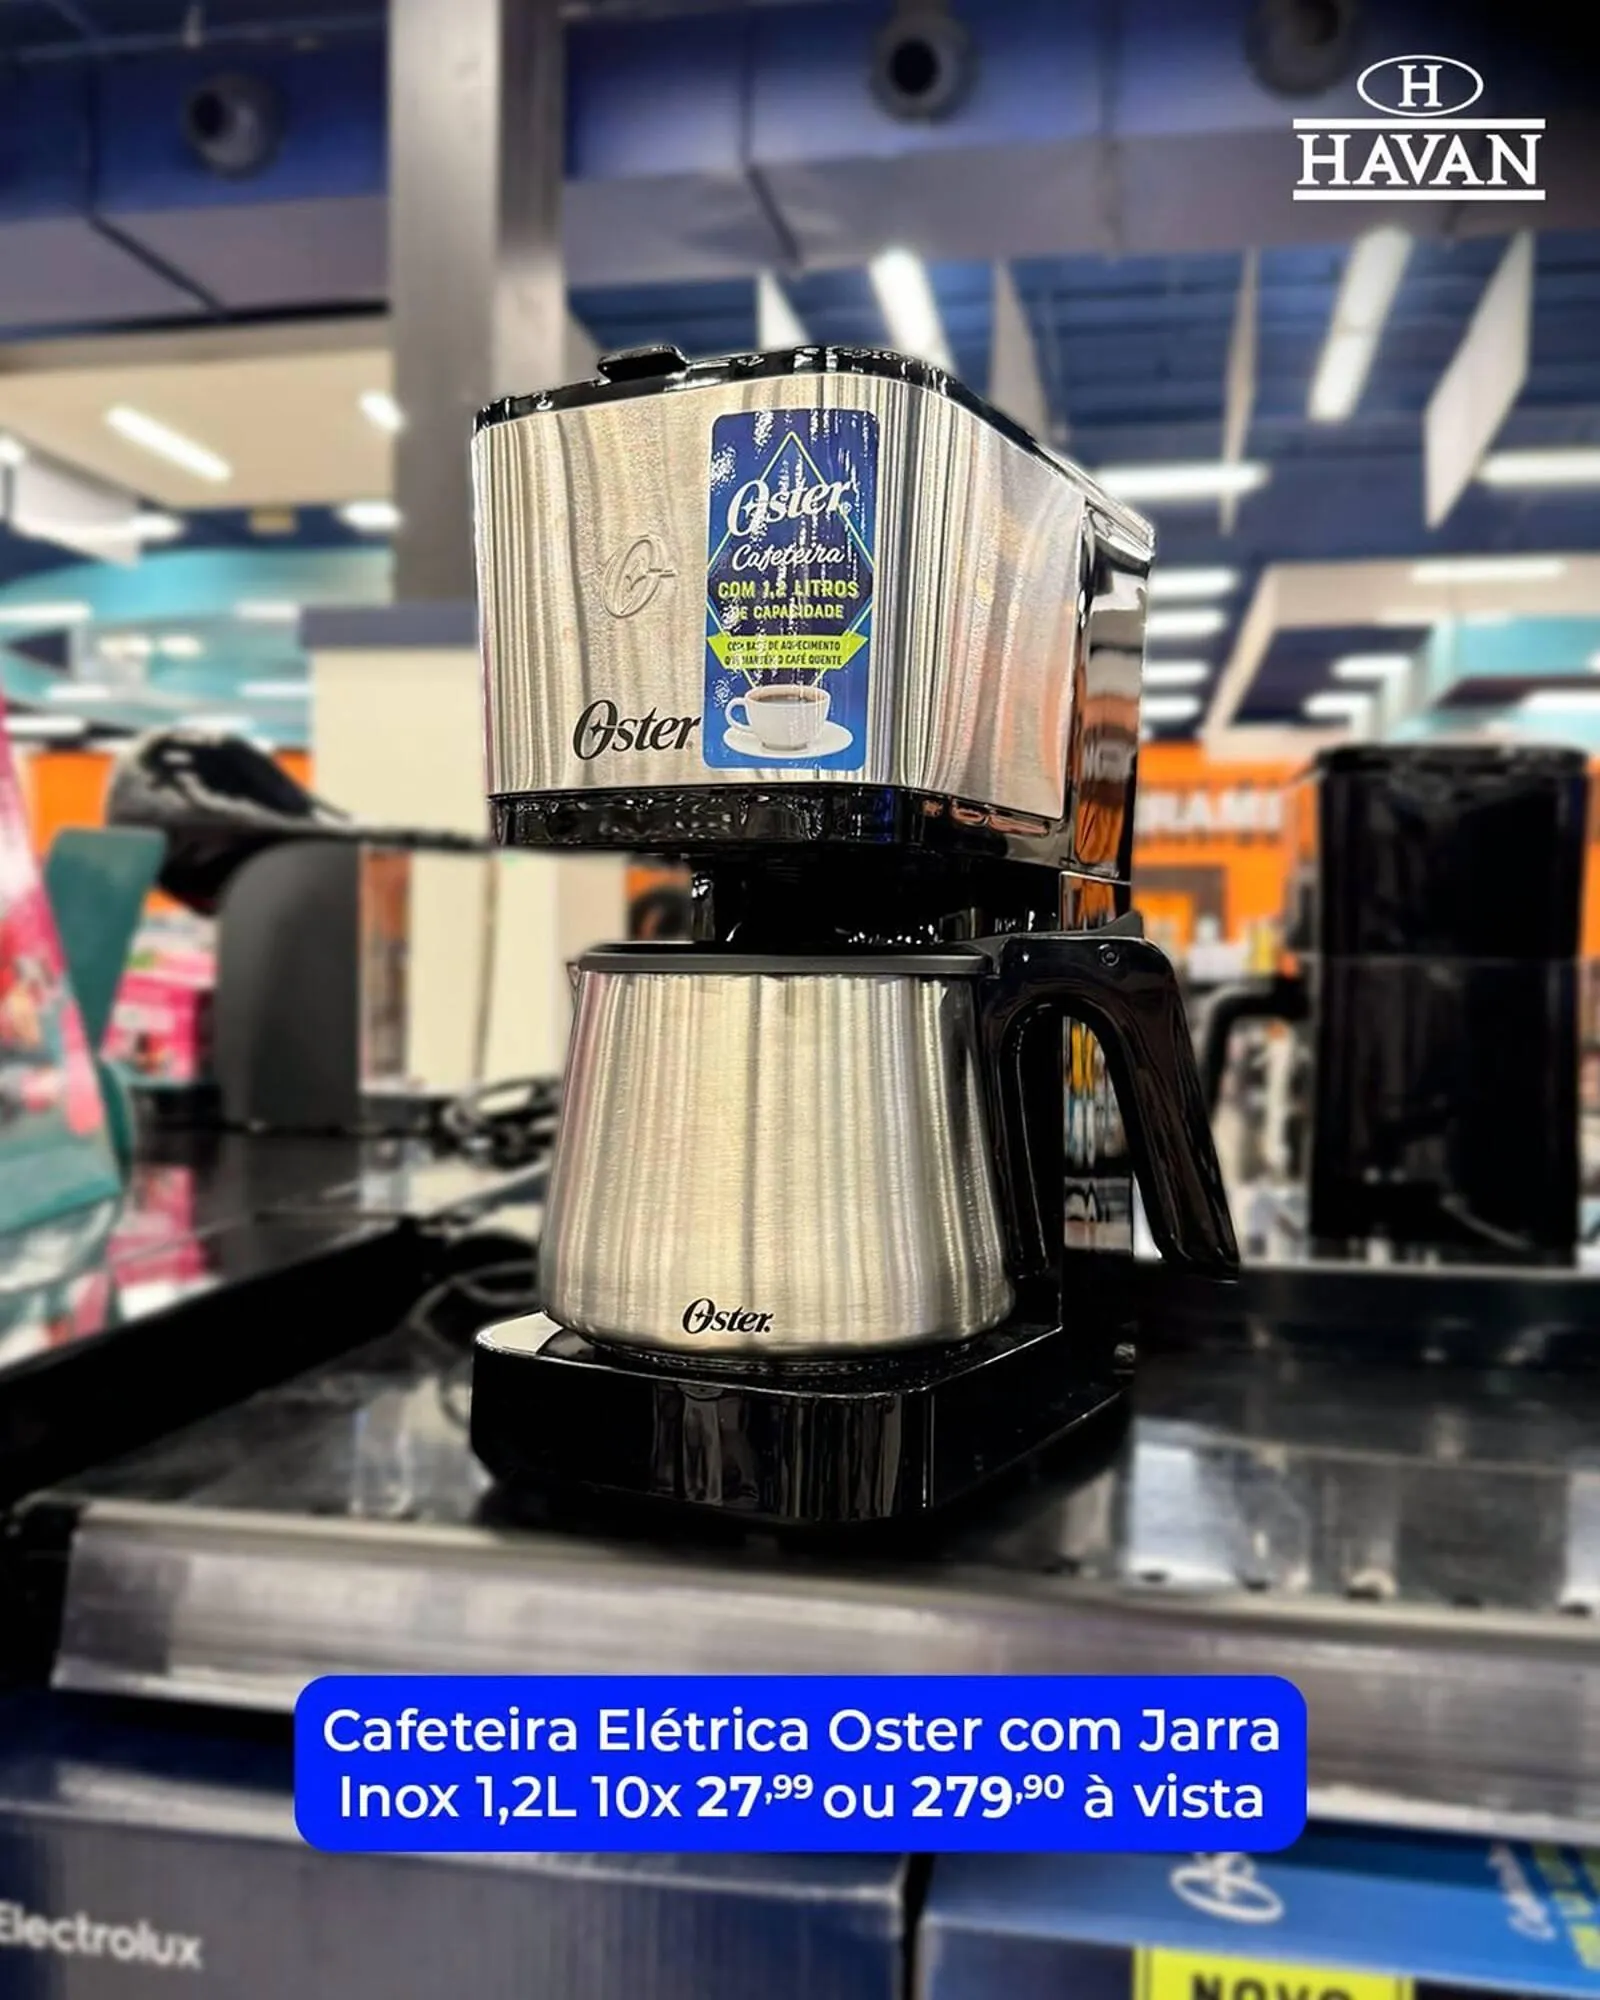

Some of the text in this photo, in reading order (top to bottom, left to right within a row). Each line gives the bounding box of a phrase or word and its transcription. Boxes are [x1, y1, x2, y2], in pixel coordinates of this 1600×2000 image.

[732, 543, 846, 572] Cafeteira
[718, 579, 861, 599] COM 1,2 LITROS
[768, 641, 779, 650] DE
[785, 652, 806, 665] CAFÉ
[808, 655, 842, 665] QUENTE
